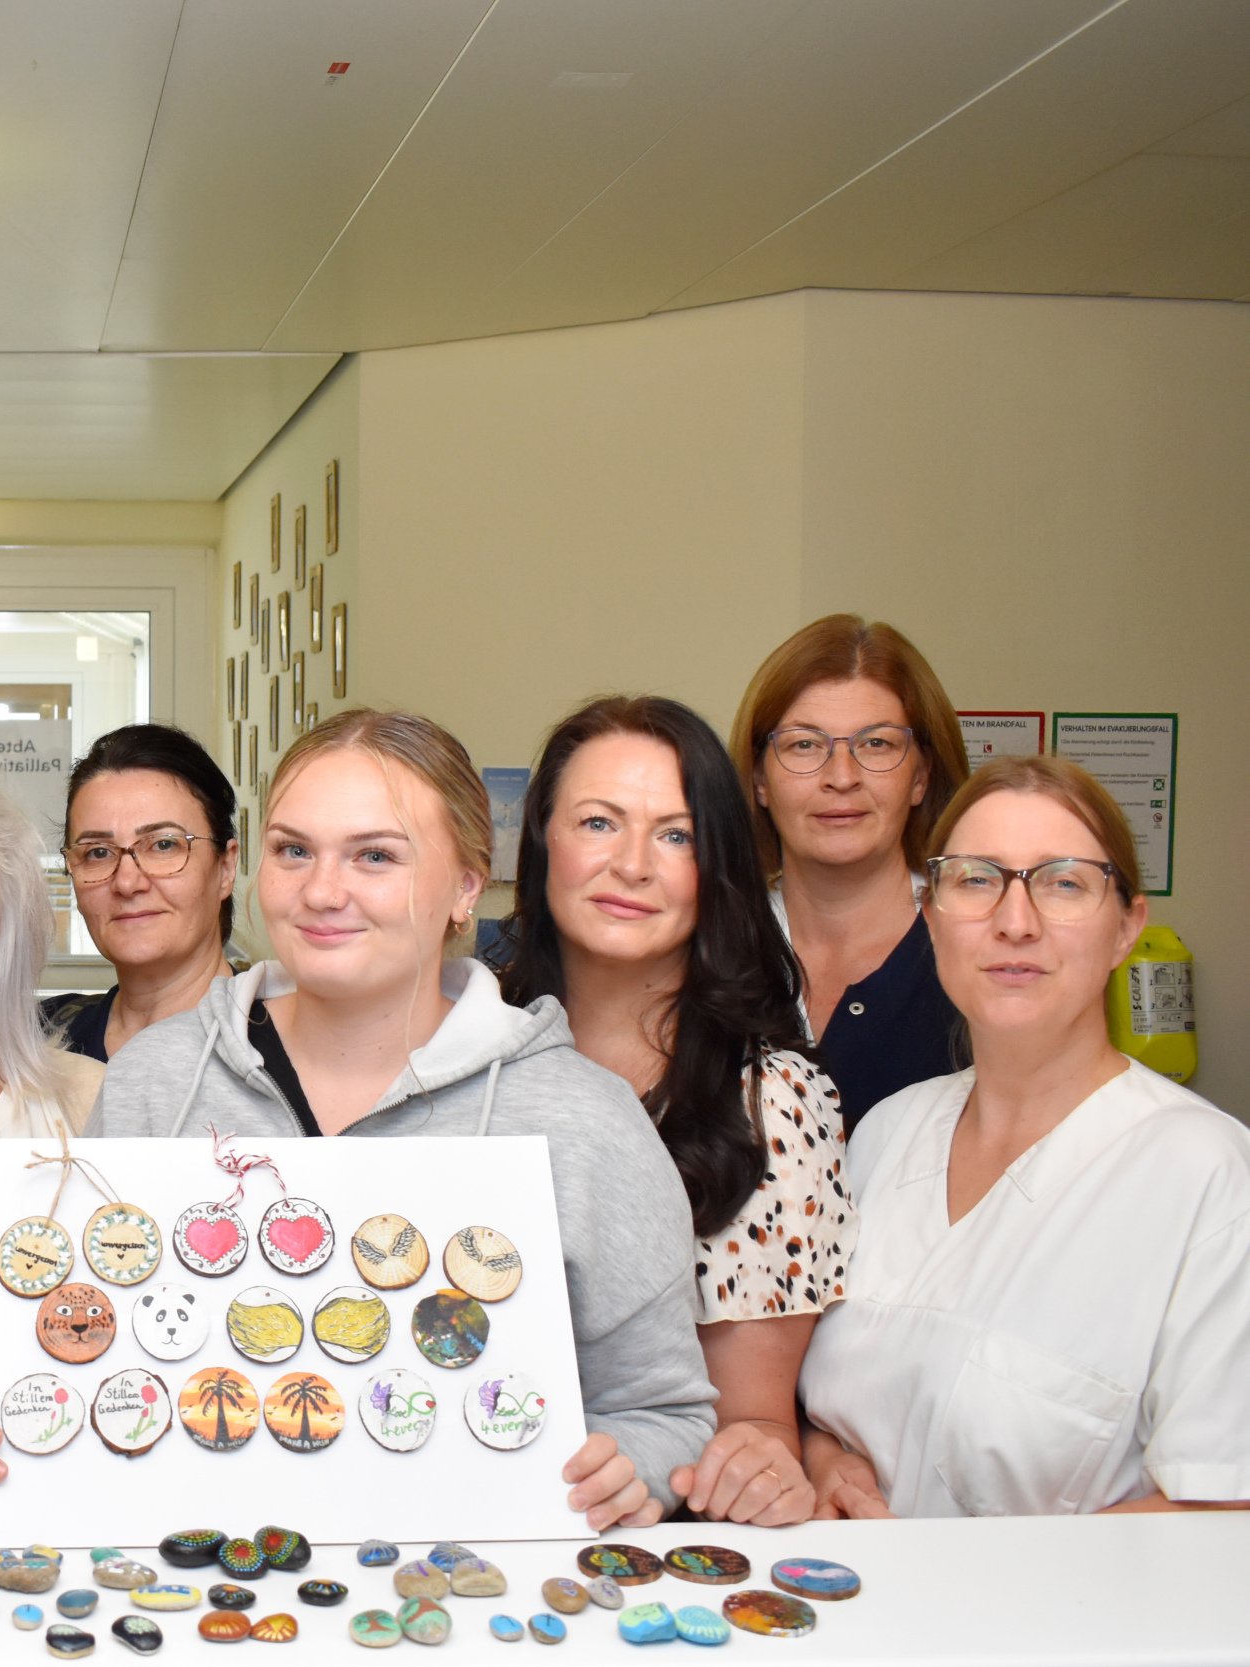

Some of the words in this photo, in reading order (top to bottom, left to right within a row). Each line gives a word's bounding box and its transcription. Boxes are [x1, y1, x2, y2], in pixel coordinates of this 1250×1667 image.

[976, 720, 985, 728] IM
[986, 720, 1027, 728] BRANDFALL
[1060, 724, 1097, 732] VERHALTEN
[1098, 725, 1107, 733] IM
[1107, 725, 1170, 733] EVAKUIERUNGSFALL
[120, 1377, 134, 1387] In
[28, 1382, 43, 1393] In
[279, 1435, 302, 1447] MAKE
